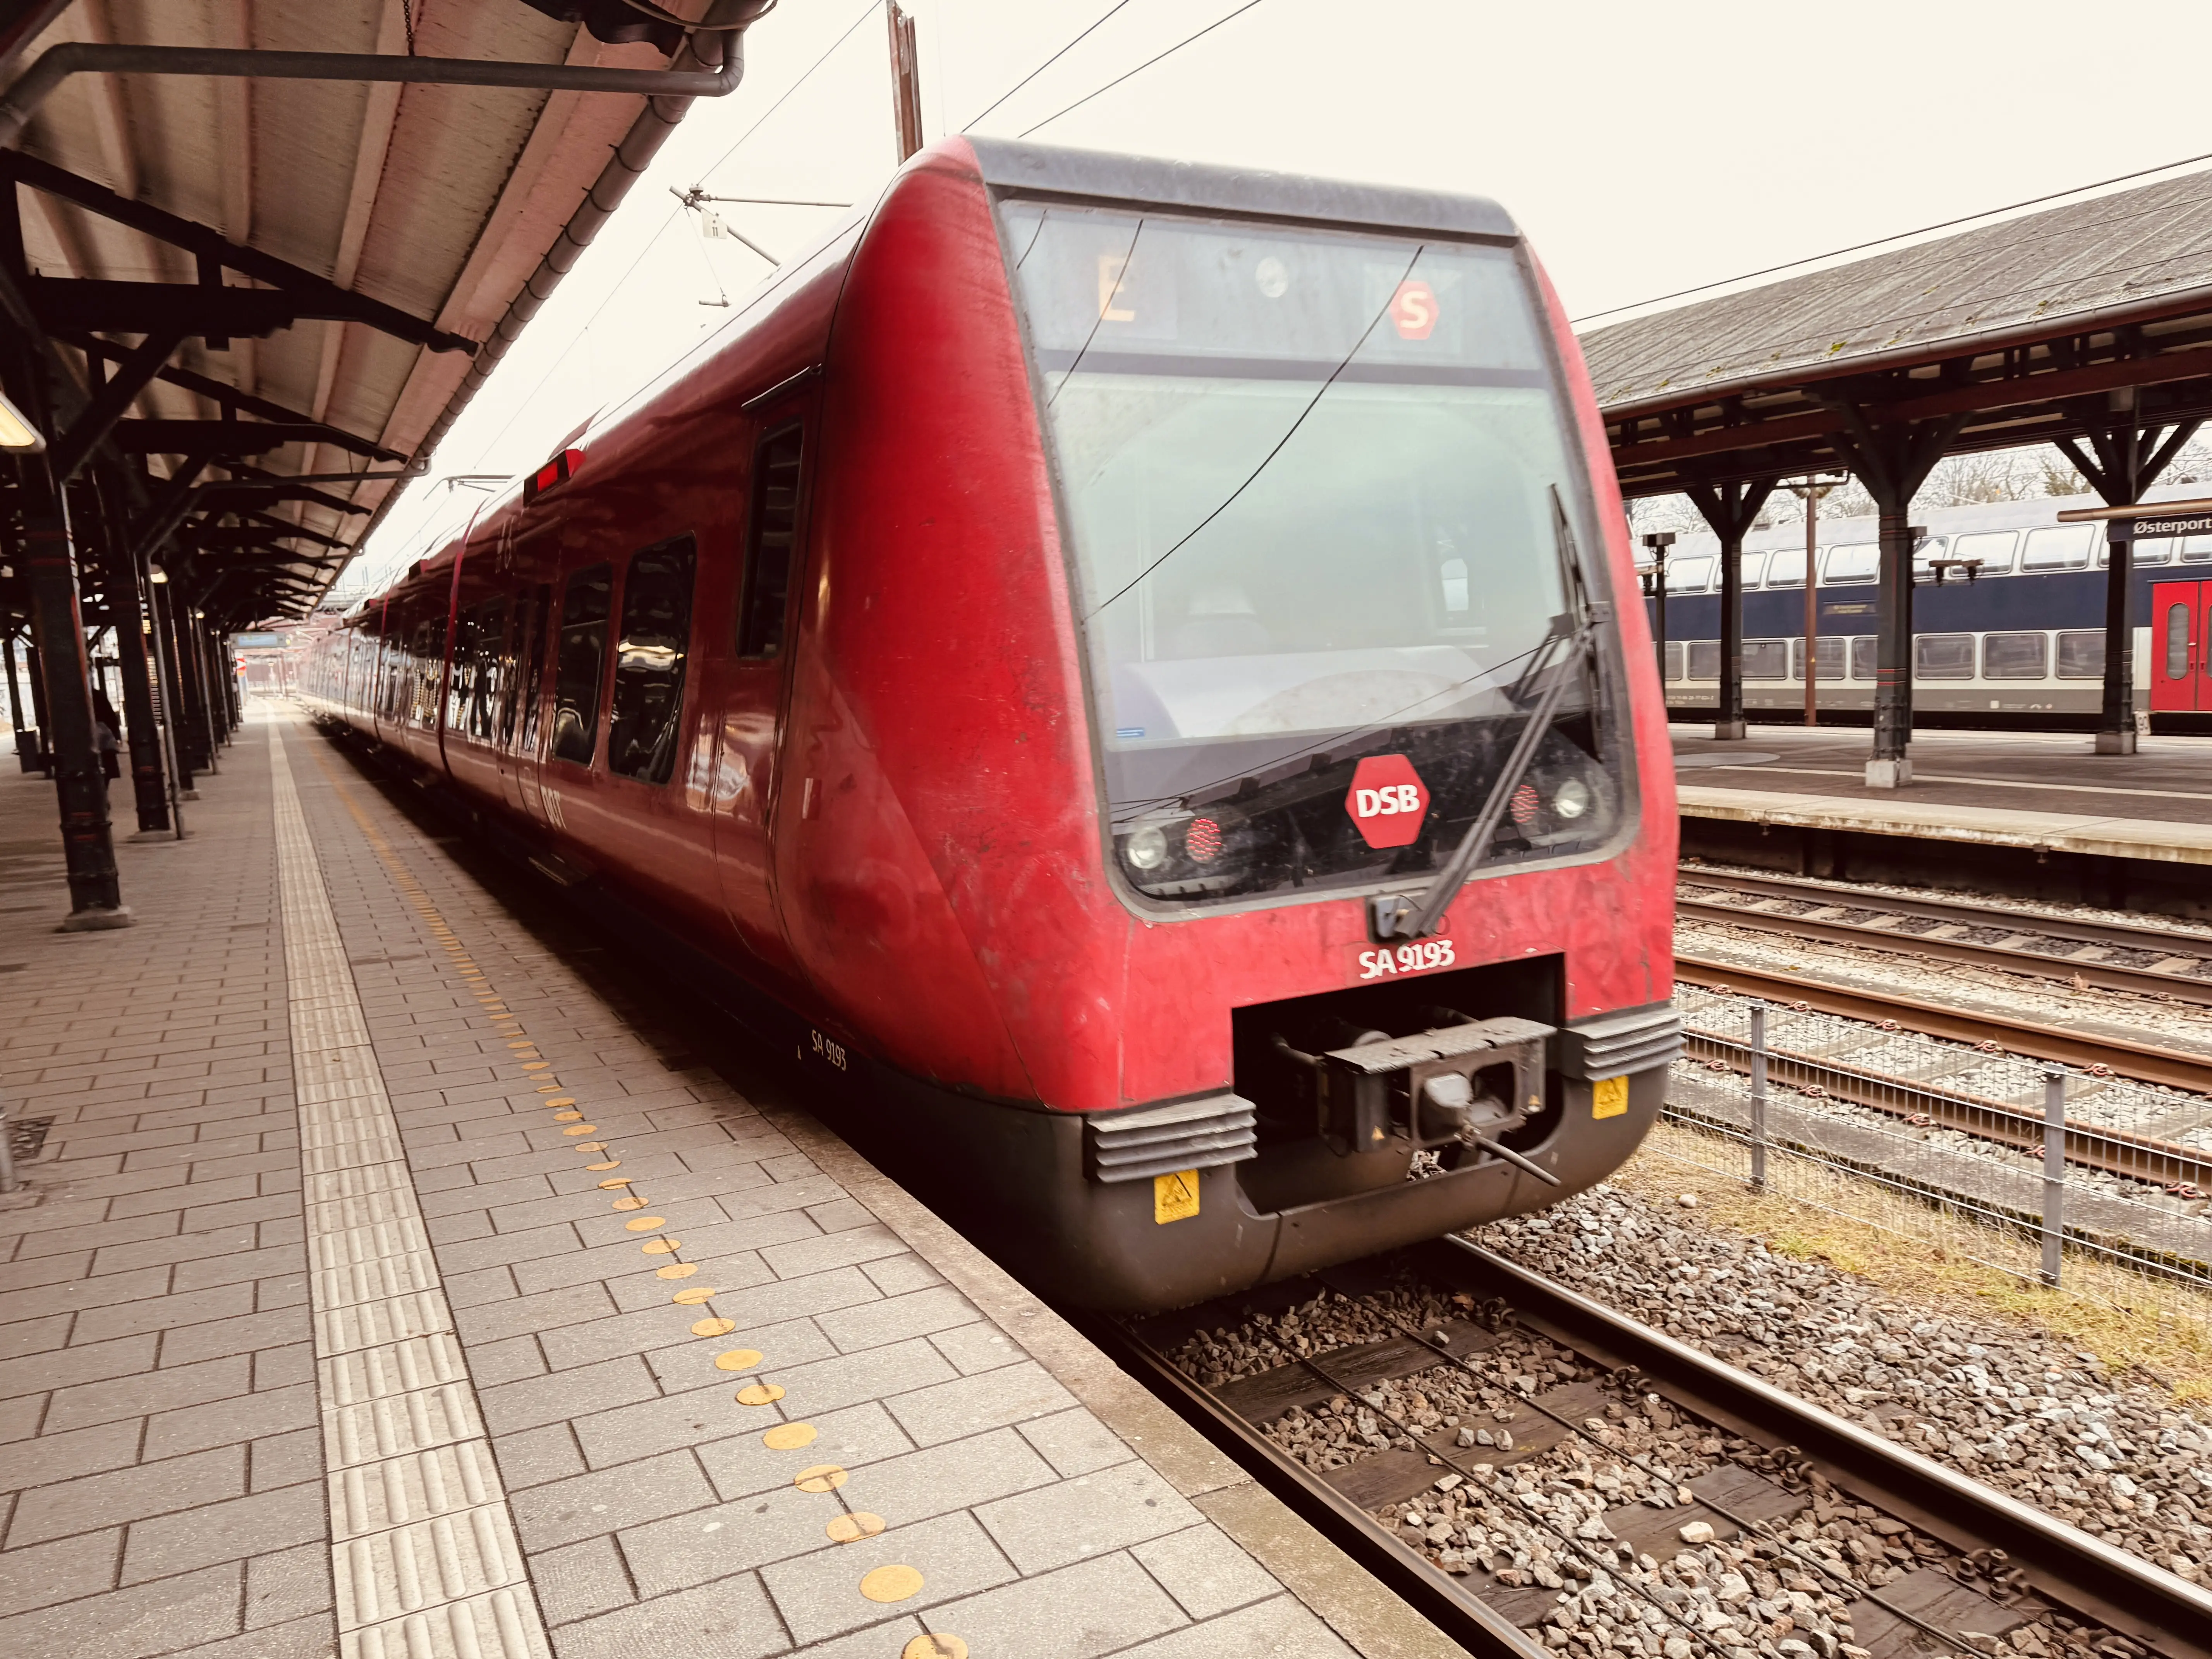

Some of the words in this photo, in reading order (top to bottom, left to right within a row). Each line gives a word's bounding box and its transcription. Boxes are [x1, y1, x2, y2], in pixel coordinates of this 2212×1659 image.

[1099, 256, 1134, 321] E
[1400, 291, 1429, 329] S
[2133, 517, 2212, 534] Østerport
[1356, 784, 1420, 817] DSB
[1358, 949, 1398, 979] SA
[1396, 939, 1455, 972] 9193
[812, 1029, 823, 1056] SA
[826, 1038, 846, 1071] 9193
